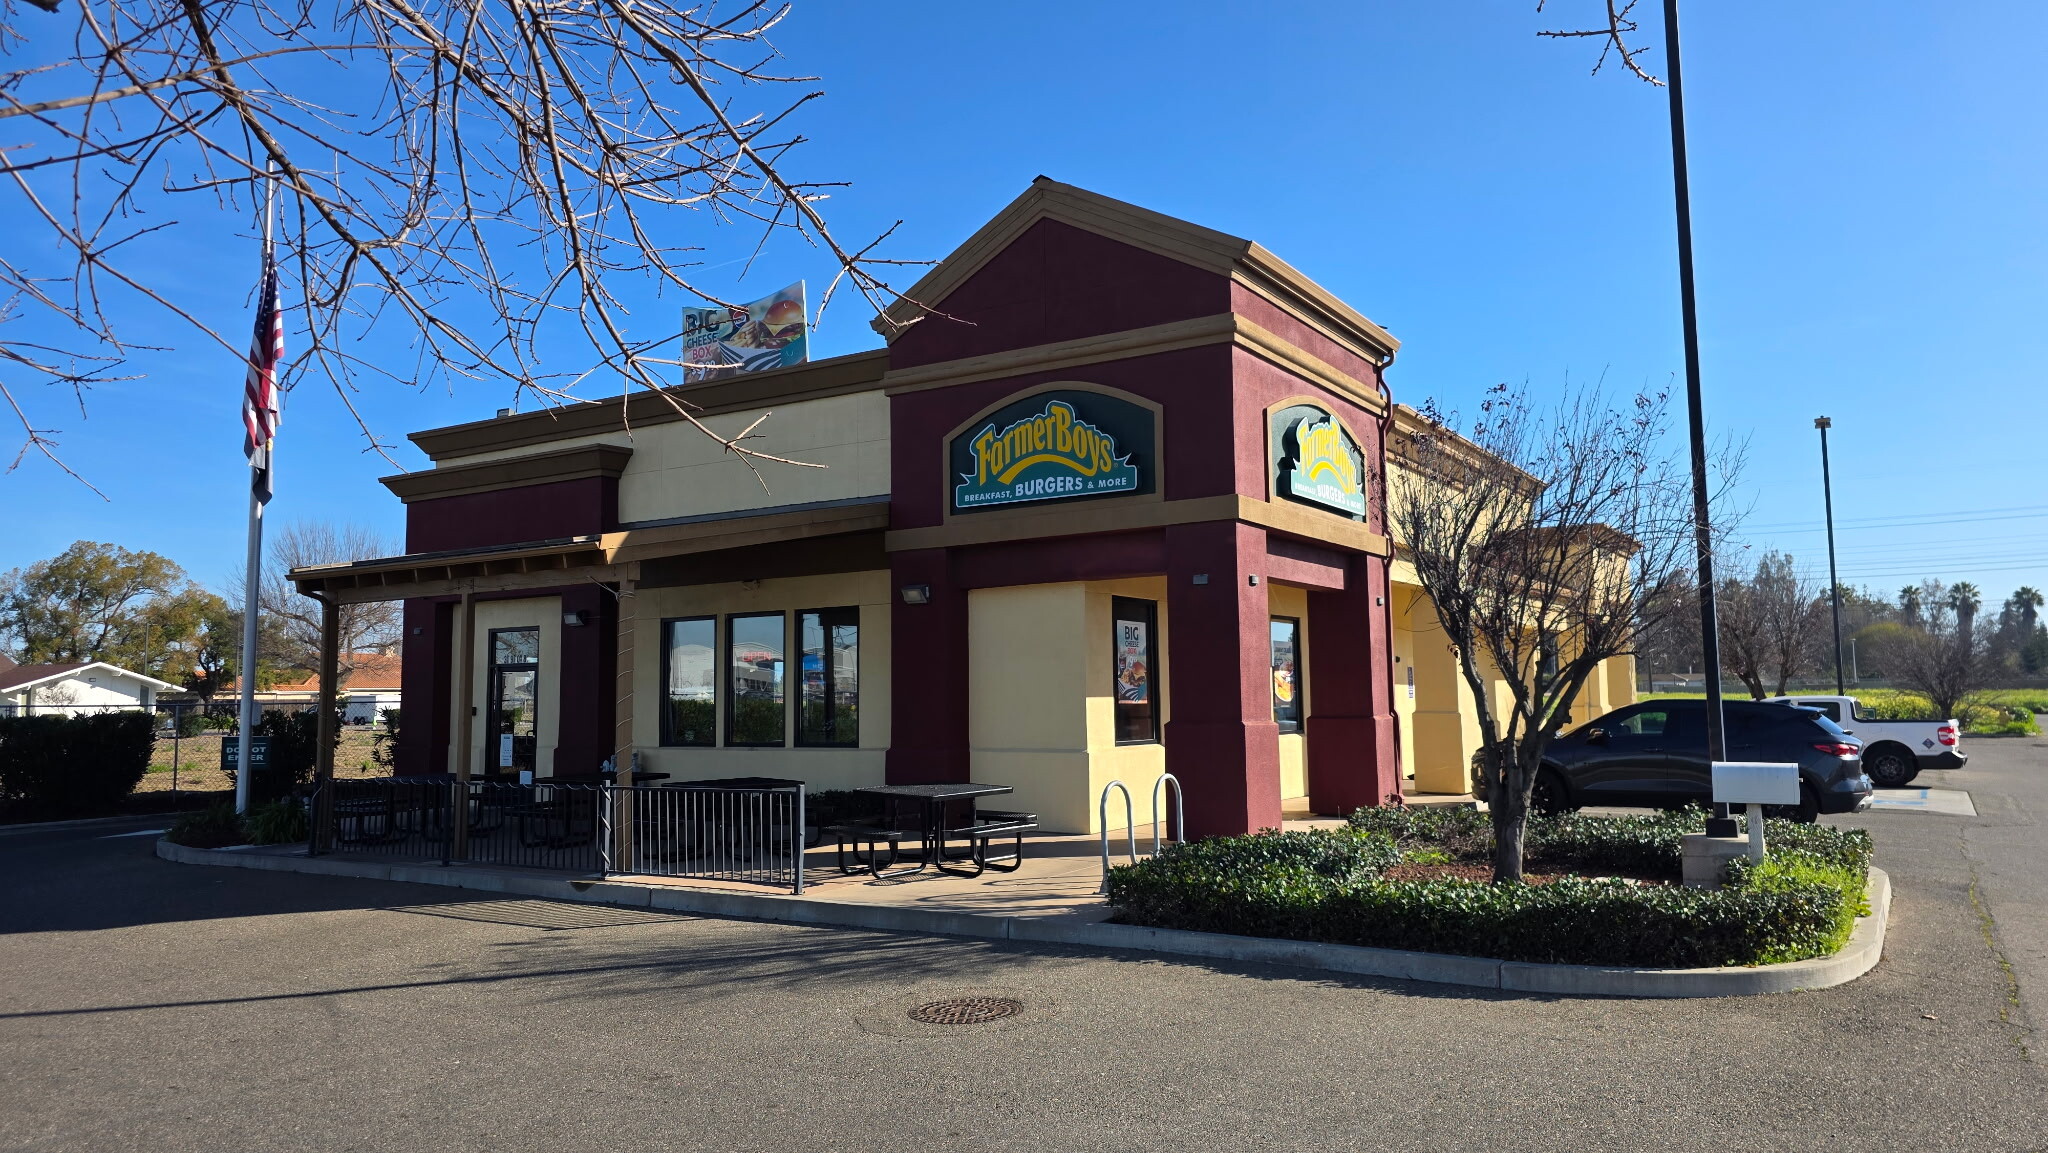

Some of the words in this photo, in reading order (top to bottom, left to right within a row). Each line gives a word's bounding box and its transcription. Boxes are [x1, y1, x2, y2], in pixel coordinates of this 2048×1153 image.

[686, 310, 720, 337] BIG
[687, 333, 718, 349] CHEESE
[692, 345, 711, 360] BOX
[964, 490, 1013, 502] BREAKFAST,
[1015, 476, 1083, 497] BURGERS
[1087, 481, 1094, 489] &
[1098, 477, 1127, 488] MORE
[1124, 625, 1139, 640] BIG
